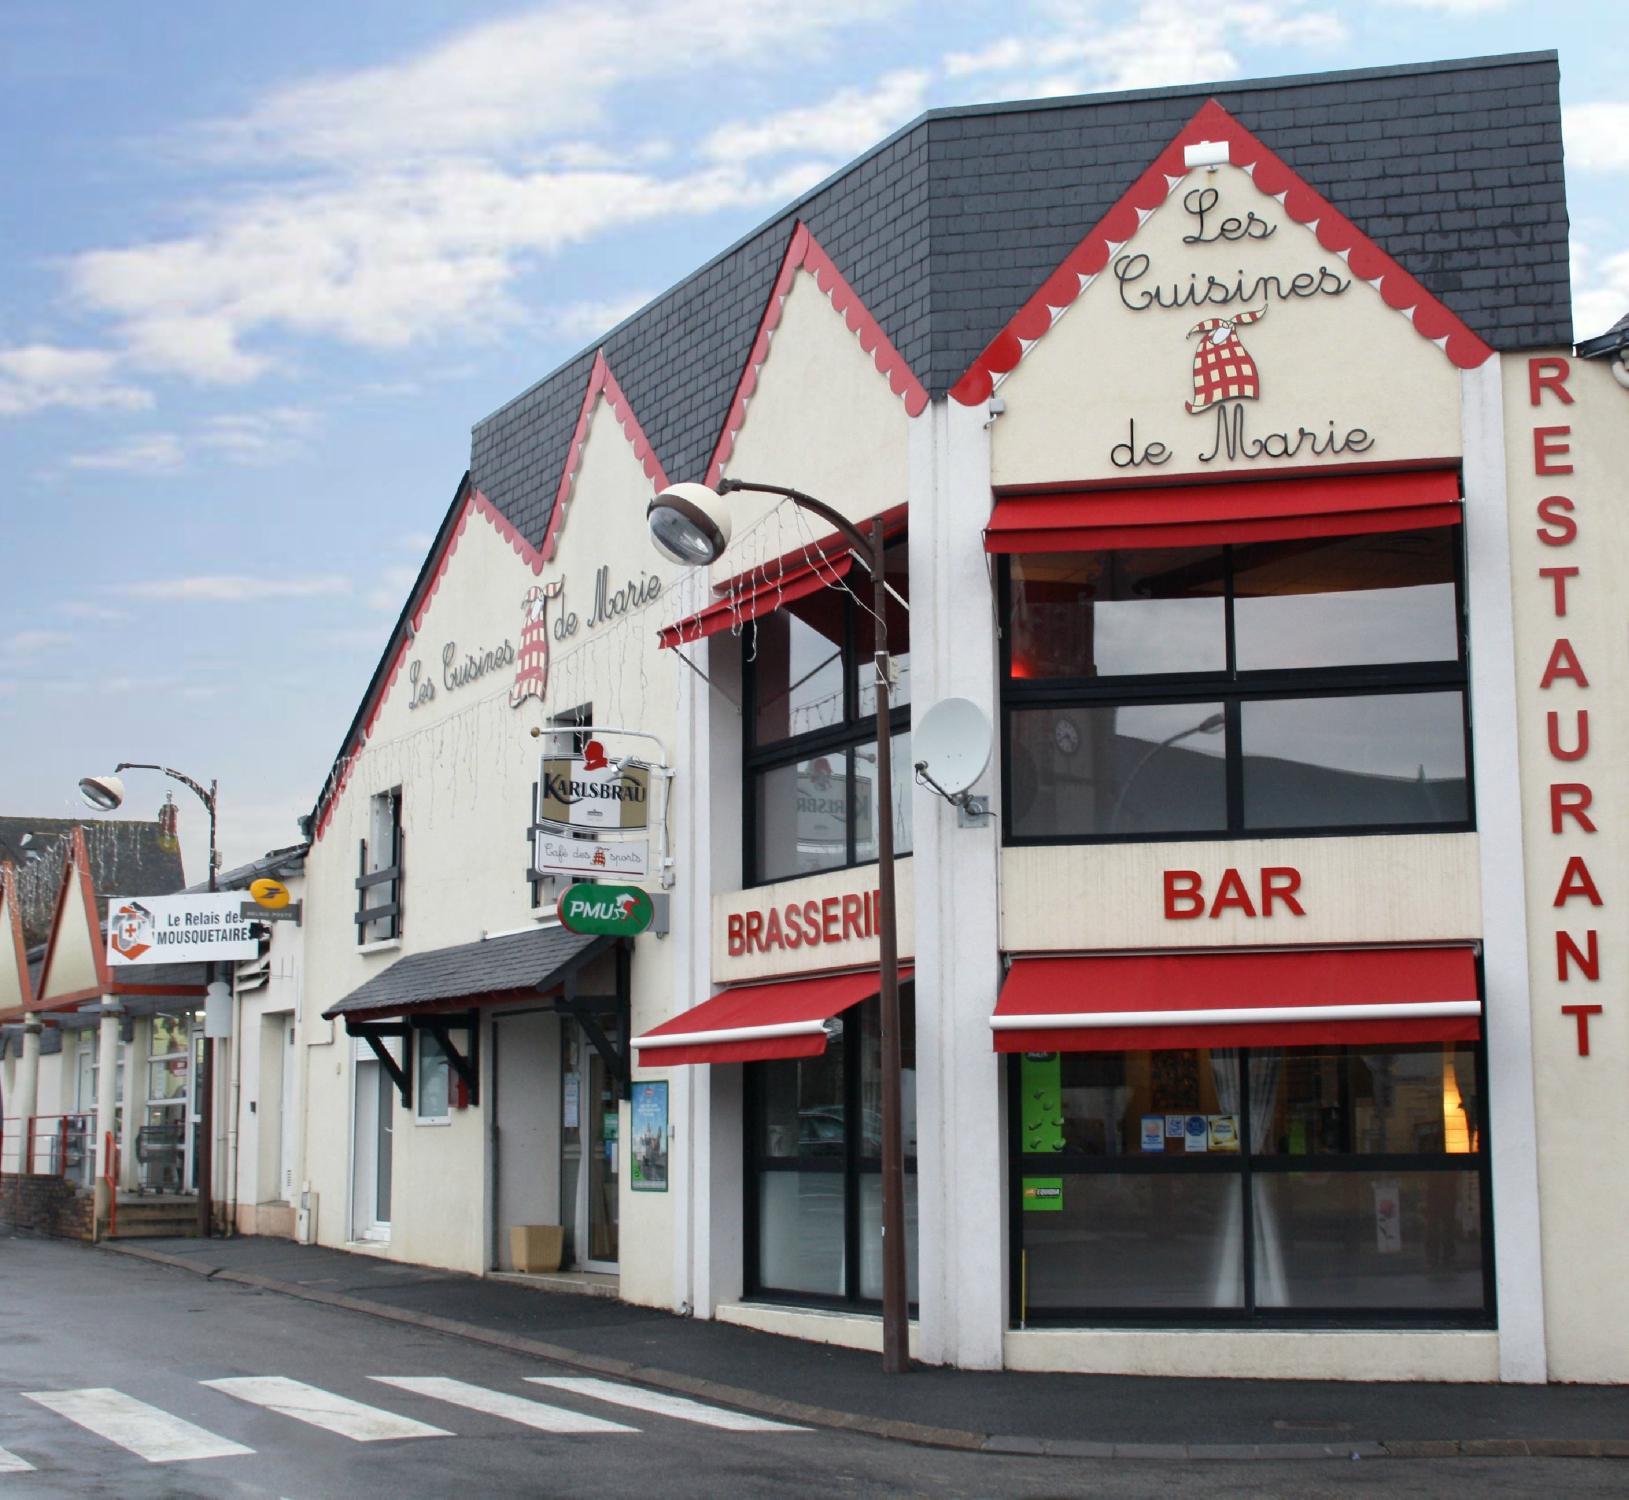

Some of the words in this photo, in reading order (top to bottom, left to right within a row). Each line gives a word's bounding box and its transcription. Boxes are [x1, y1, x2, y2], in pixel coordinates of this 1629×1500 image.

[1183, 188, 1277, 244] Les
[1114, 253, 1351, 310] Cuisines
[1110, 417, 1173, 467] de
[1198, 403, 1376, 462] Marie
[408, 659, 435, 710] Les
[442, 639, 515, 691] Cuisines
[553, 592, 579, 642] de
[587, 564, 662, 628] Marie
[1528, 356, 1603, 1057] RESTAURANT
[572, 846, 590, 859] des
[168, 913, 181, 927] Le
[185, 912, 220, 926] Relais
[569, 900, 614, 920] PMU
[1163, 866, 1307, 920] BAR
